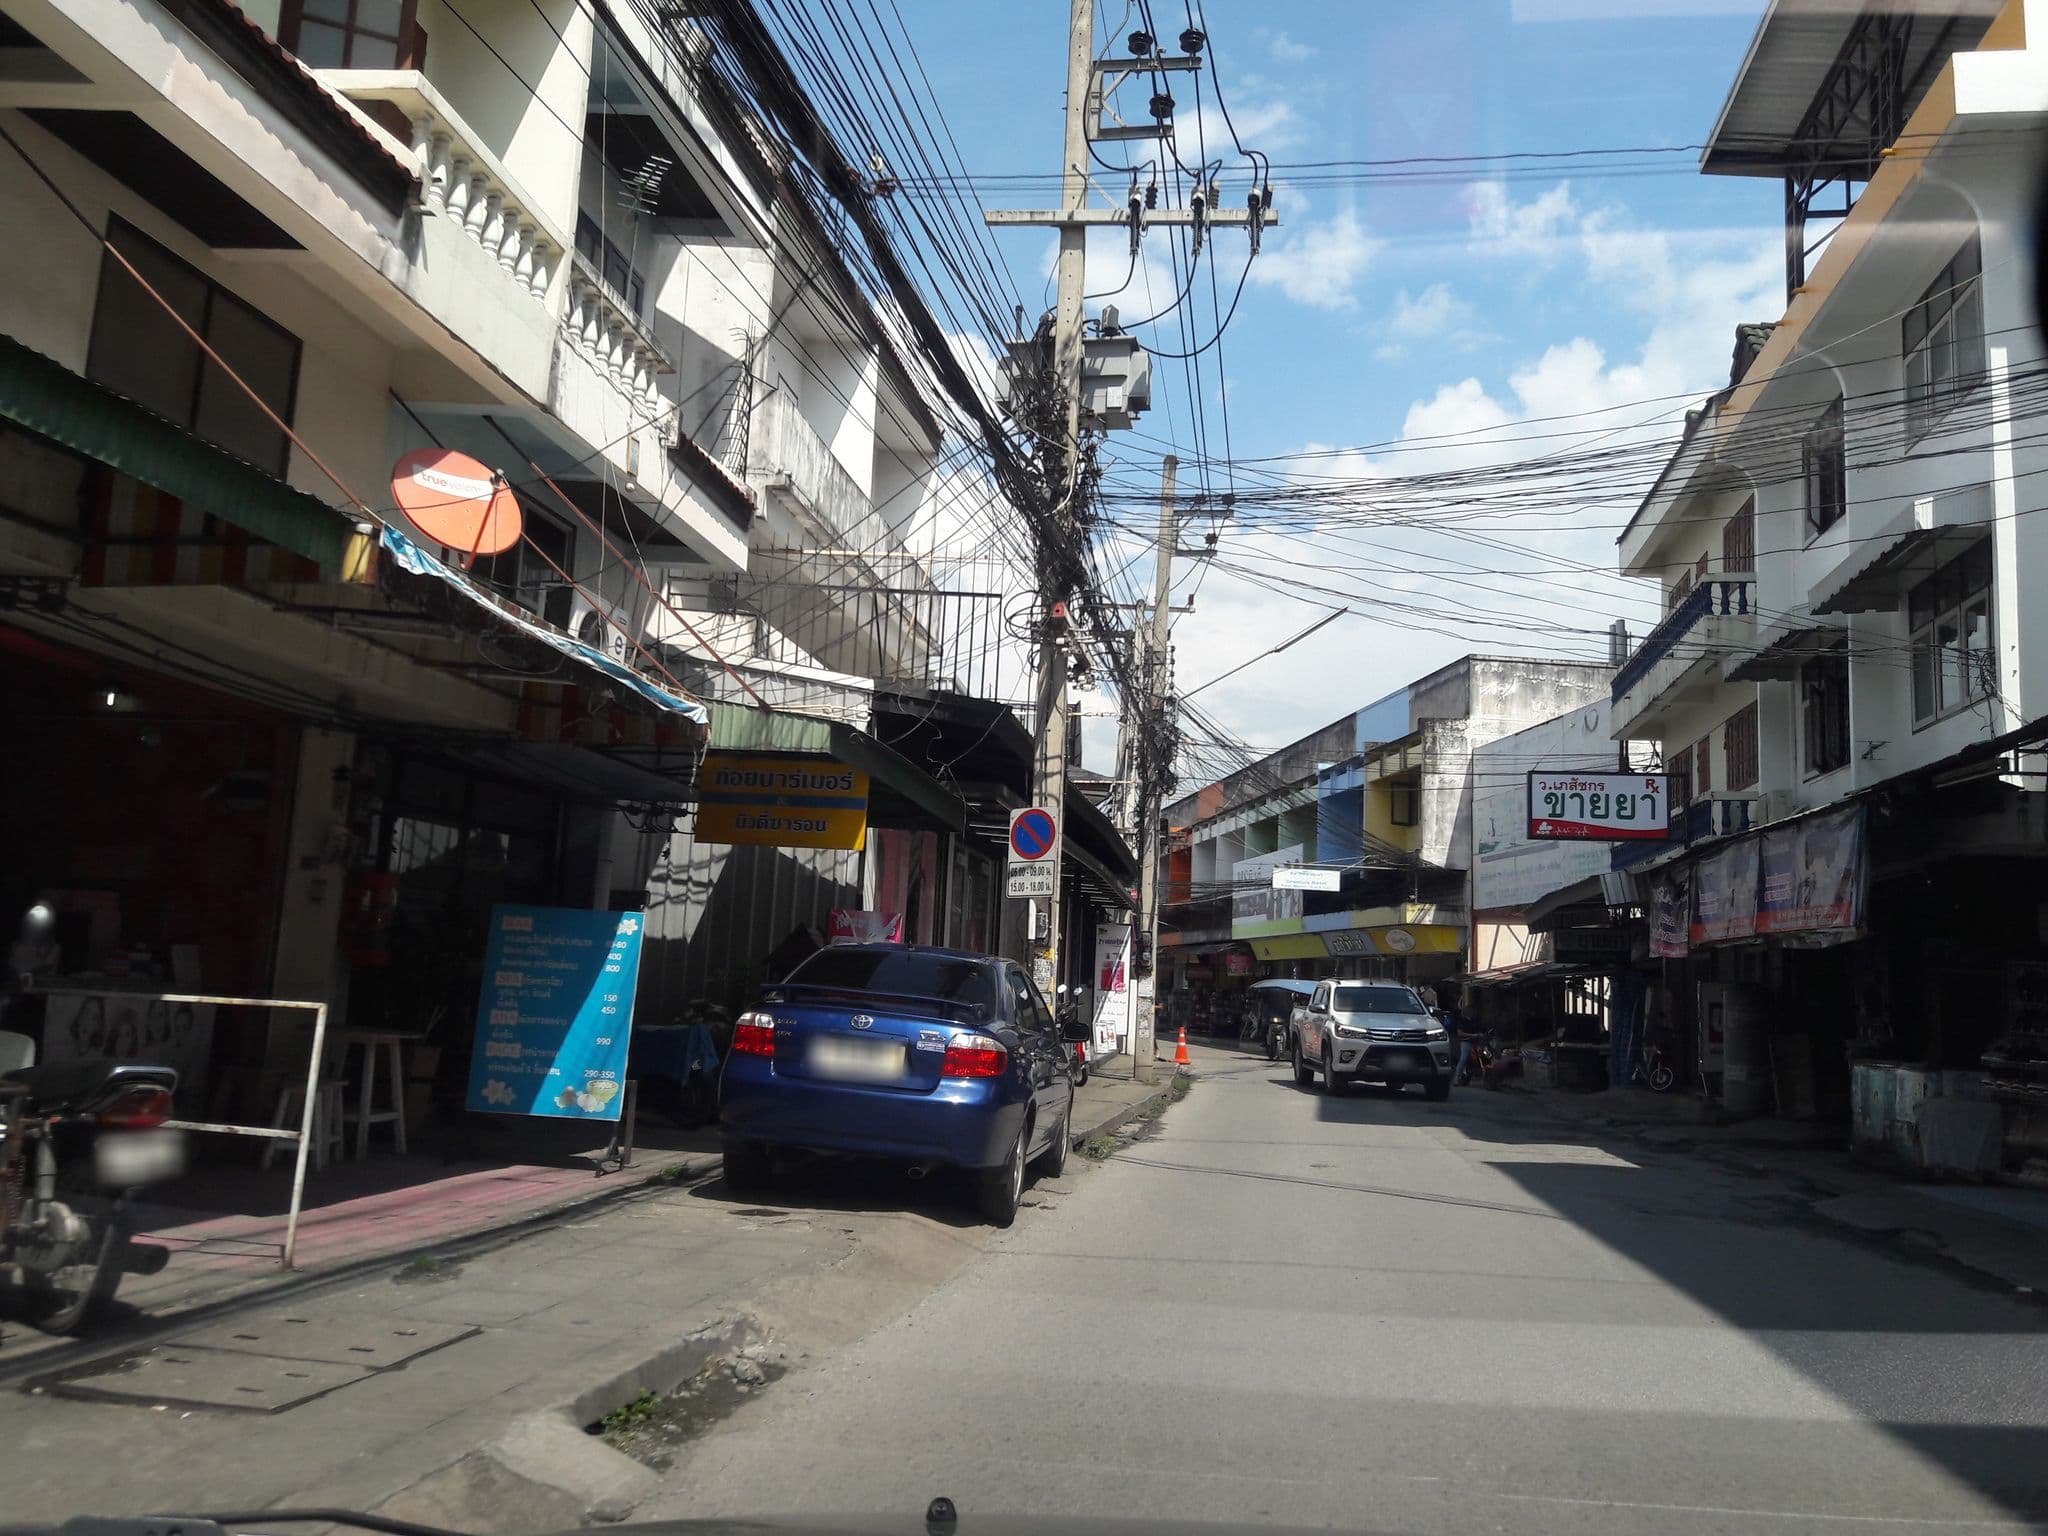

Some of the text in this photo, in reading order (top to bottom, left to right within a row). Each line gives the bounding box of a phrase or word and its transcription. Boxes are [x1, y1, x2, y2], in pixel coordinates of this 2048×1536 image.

[1543, 792, 1657, 820] ขายยา
[603, 994, 618, 1002] 150
[600, 1006, 616, 1014] 450
[596, 1037, 611, 1045] 990
[583, 1068, 615, 1079] 290-350
